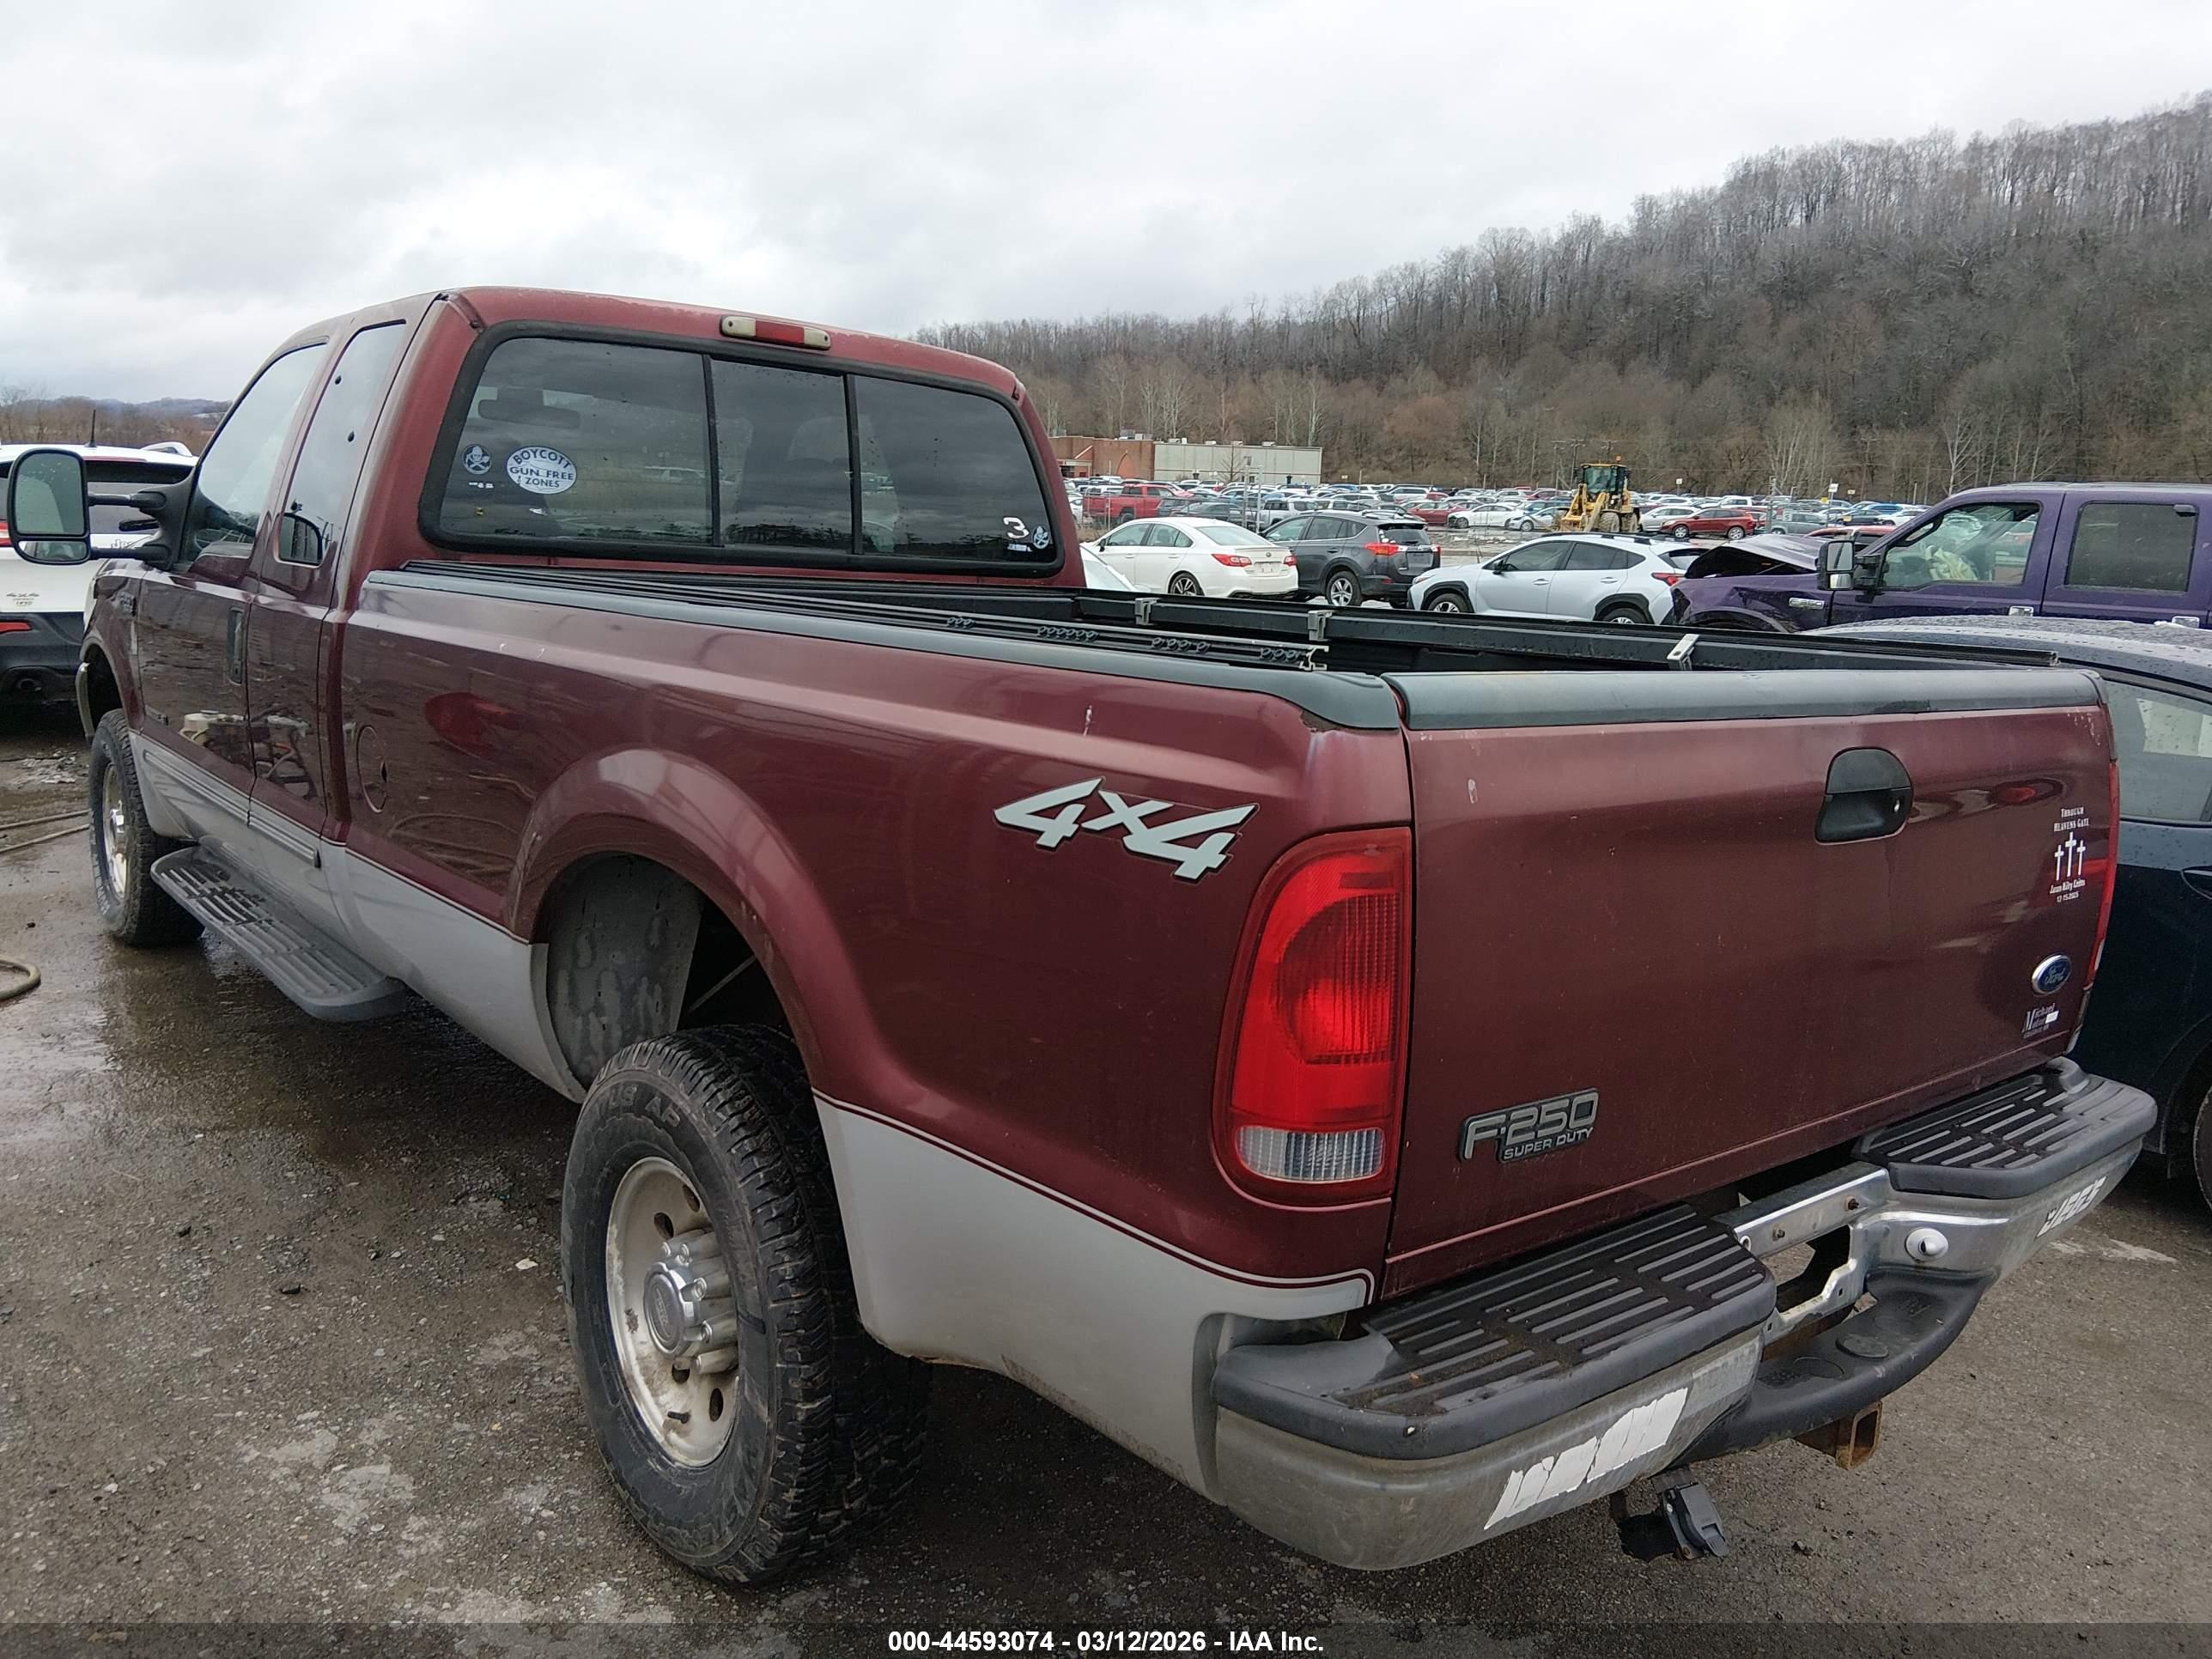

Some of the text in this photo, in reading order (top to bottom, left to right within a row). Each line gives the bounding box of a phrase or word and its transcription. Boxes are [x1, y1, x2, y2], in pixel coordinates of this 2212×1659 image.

[514, 448, 572, 469] BOYCOTT
[510, 466, 574, 481] GUN FREE
[525, 477, 560, 488] ZONES
[1003, 516, 1030, 539] 3
[1503, 1126, 1594, 1160] SUPER DUTY
